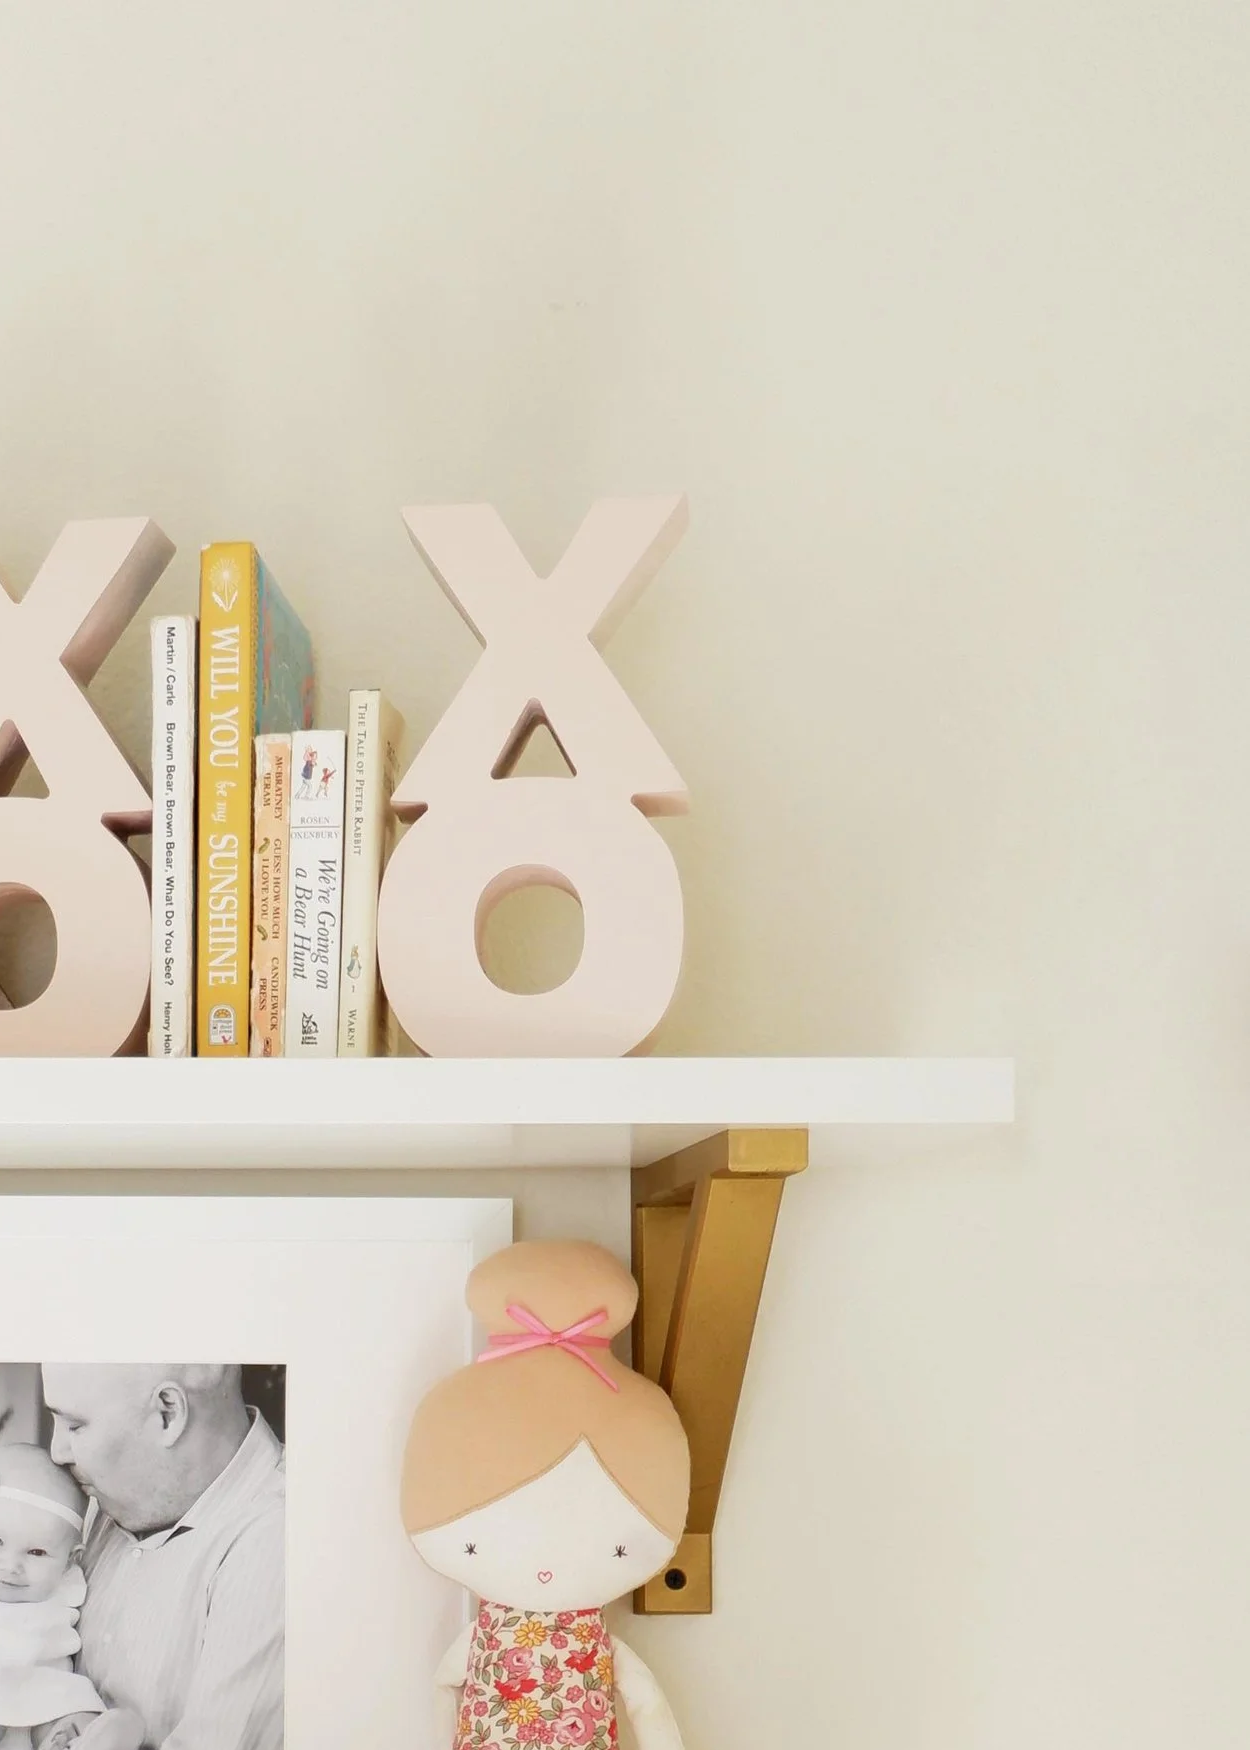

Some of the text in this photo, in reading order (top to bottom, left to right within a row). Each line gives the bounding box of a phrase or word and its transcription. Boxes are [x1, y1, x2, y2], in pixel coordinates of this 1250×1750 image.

[166, 626, 176, 665] Martin
[210, 624, 240, 700] WILL
[166, 674, 176, 706] Carle
[357, 703, 368, 727] THE
[166, 722, 176, 760] Brown
[209, 706, 240, 769] YOU
[356, 730, 367, 758] TALE
[165, 765, 176, 796] Bear,
[216, 780, 237, 797] be
[262, 772, 271, 807] ERAM
[354, 779, 365, 813] PETER
[165, 799, 176, 838] Brown
[211, 801, 227, 823] my
[300, 816, 330, 825] ROSEN
[290, 831, 340, 840] OXENBURY
[353, 817, 364, 856] RABBIT
[165, 842, 175, 872] Bear,
[165, 876, 175, 906] What
[261, 863, 269, 895] LOVE
[272, 838, 282, 940] GUESS HOW MUCH
[165, 910, 175, 927] Do
[208, 833, 239, 987] SUNSHINE
[261, 896, 269, 920] YOU
[292, 867, 313, 980] a Bear Hunt
[310, 859, 337, 990] We're Going on
[164, 929, 175, 954] You
[164, 958, 174, 986] See?
[258, 977, 267, 1012] PRESS
[270, 956, 279, 1031] CANDLEWICK
[162, 1001, 172, 1031] Henry
[347, 1008, 357, 1049] WARNE
[163, 1034, 172, 1055] Holt
